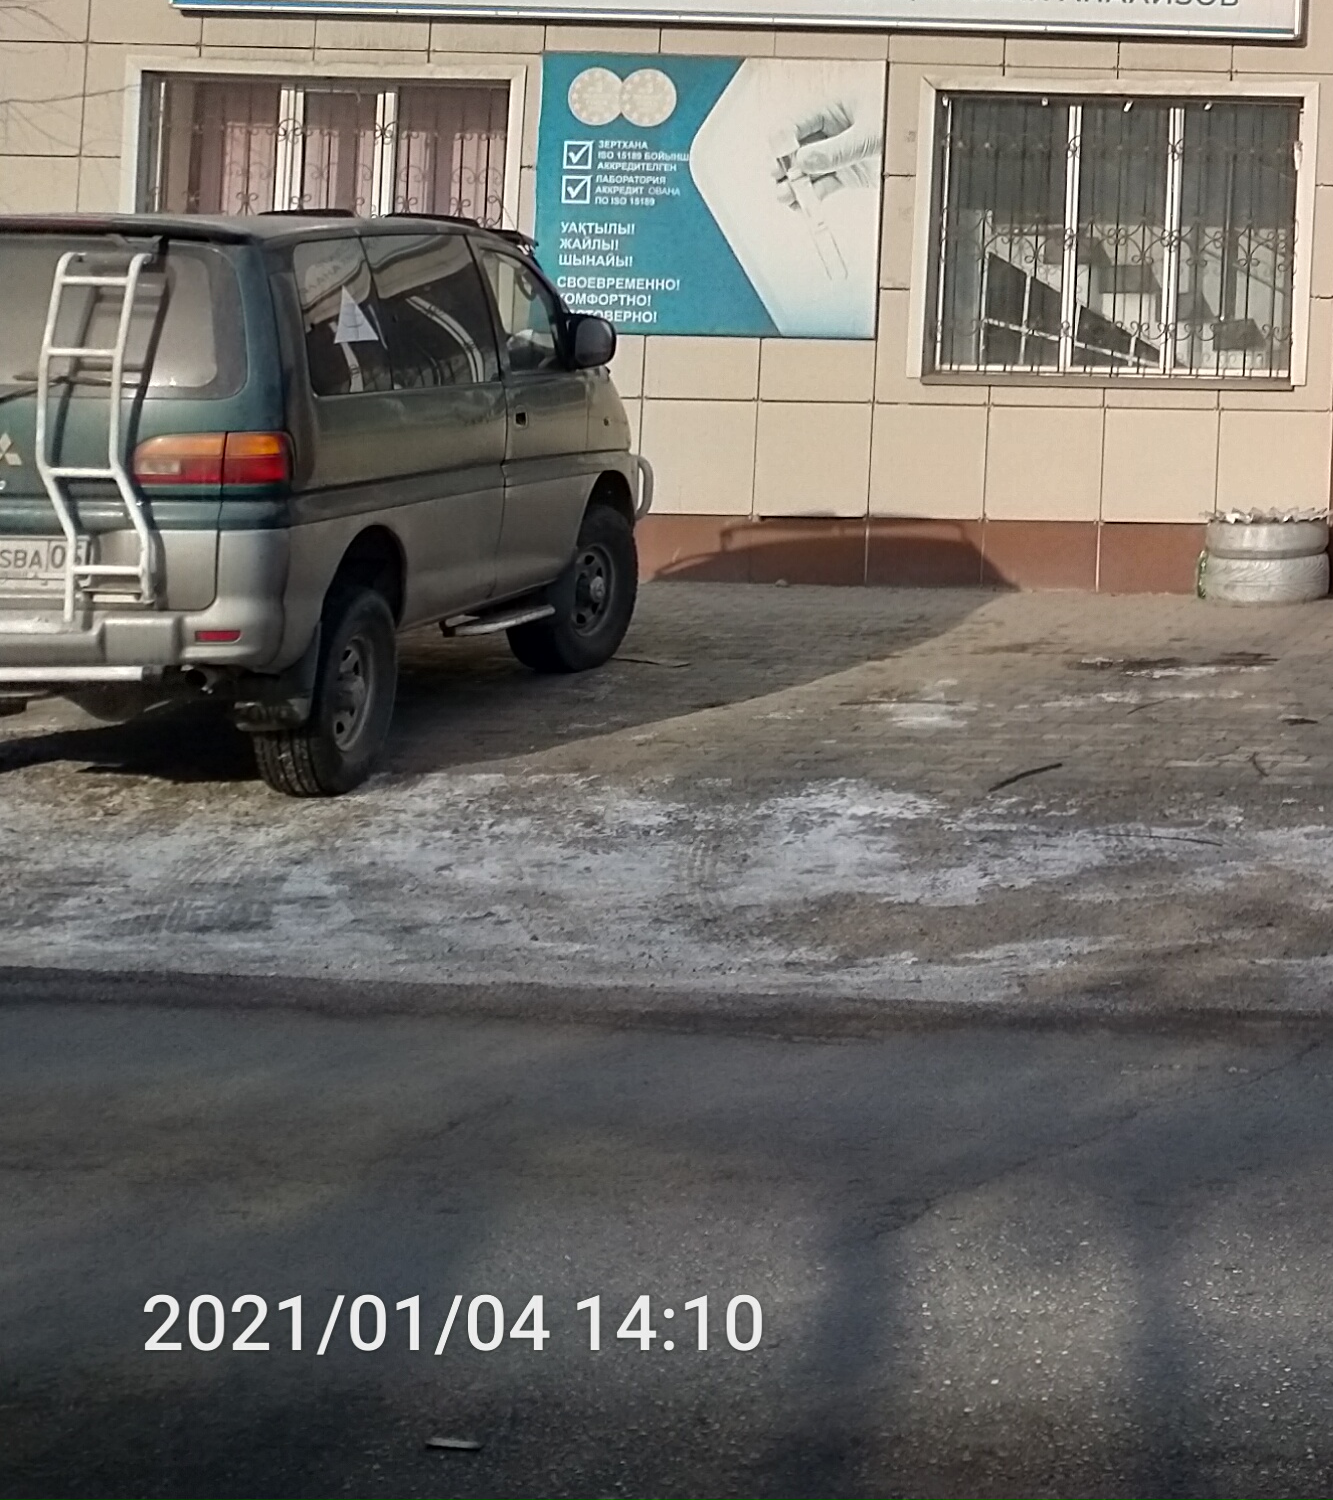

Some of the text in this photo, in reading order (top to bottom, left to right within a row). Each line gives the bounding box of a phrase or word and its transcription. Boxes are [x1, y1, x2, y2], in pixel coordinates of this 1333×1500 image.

[598, 140, 649, 150] ЗЕРТХАНА
[597, 151, 614, 160] ISO
[596, 162, 677, 172] АККРЕДИТЕЛГЕН
[595, 174, 667, 185] ЛАБОРАТОРИЯ
[594, 196, 610, 206] ПО
[611, 196, 627, 206] ISO
[560, 221, 635, 235] УАҚТЫЛЫ!
[559, 237, 619, 251] ЖАЙЛЫ!
[558, 253, 633, 267] ШЫНАЙЫ!
[557, 276, 680, 291] СВОЕВРЕМЕННО!
[569, 309, 658, 323] ТОВЕРНО!
